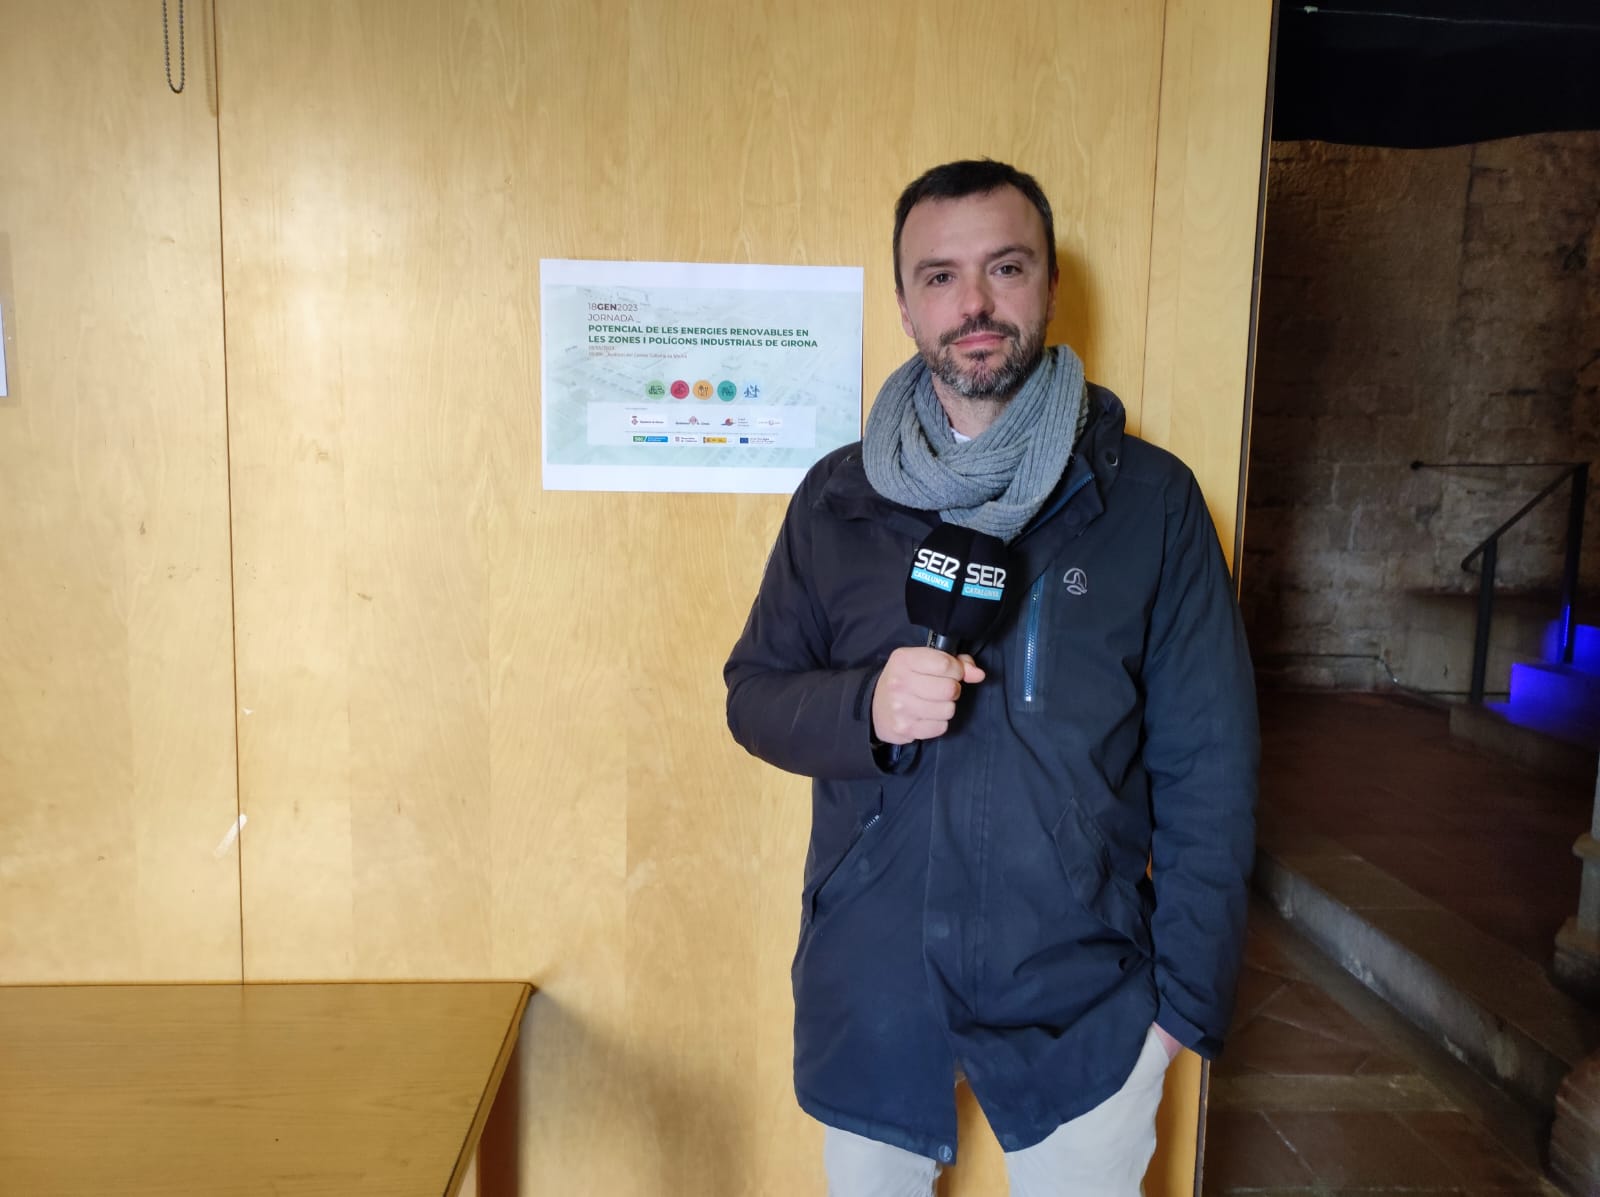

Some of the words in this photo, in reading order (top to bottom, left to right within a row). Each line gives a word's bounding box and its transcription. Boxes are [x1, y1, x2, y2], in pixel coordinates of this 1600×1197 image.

[588, 302, 638, 312] 18GEN2023
[588, 313, 634, 323] JORNADA
[588, 324, 643, 334] POTENCIAL
[645, 326, 659, 334] DE
[661, 326, 679, 335] LES
[681, 327, 728, 336] ENERGIES
[730, 328, 794, 337] RENOVABLES
[796, 329, 809, 337] EN
[588, 335, 606, 344] LES
[608, 336, 641, 344] ZONES
[643, 337, 646, 345] I
[648, 335, 698, 346] POLÍGONS
[700, 338, 763, 347] INDUSTRIALS
[765, 339, 778, 347] DE
[780, 340, 818, 348] GIRONA
[914, 548, 961, 580] SER
[964, 562, 1007, 589] SER
